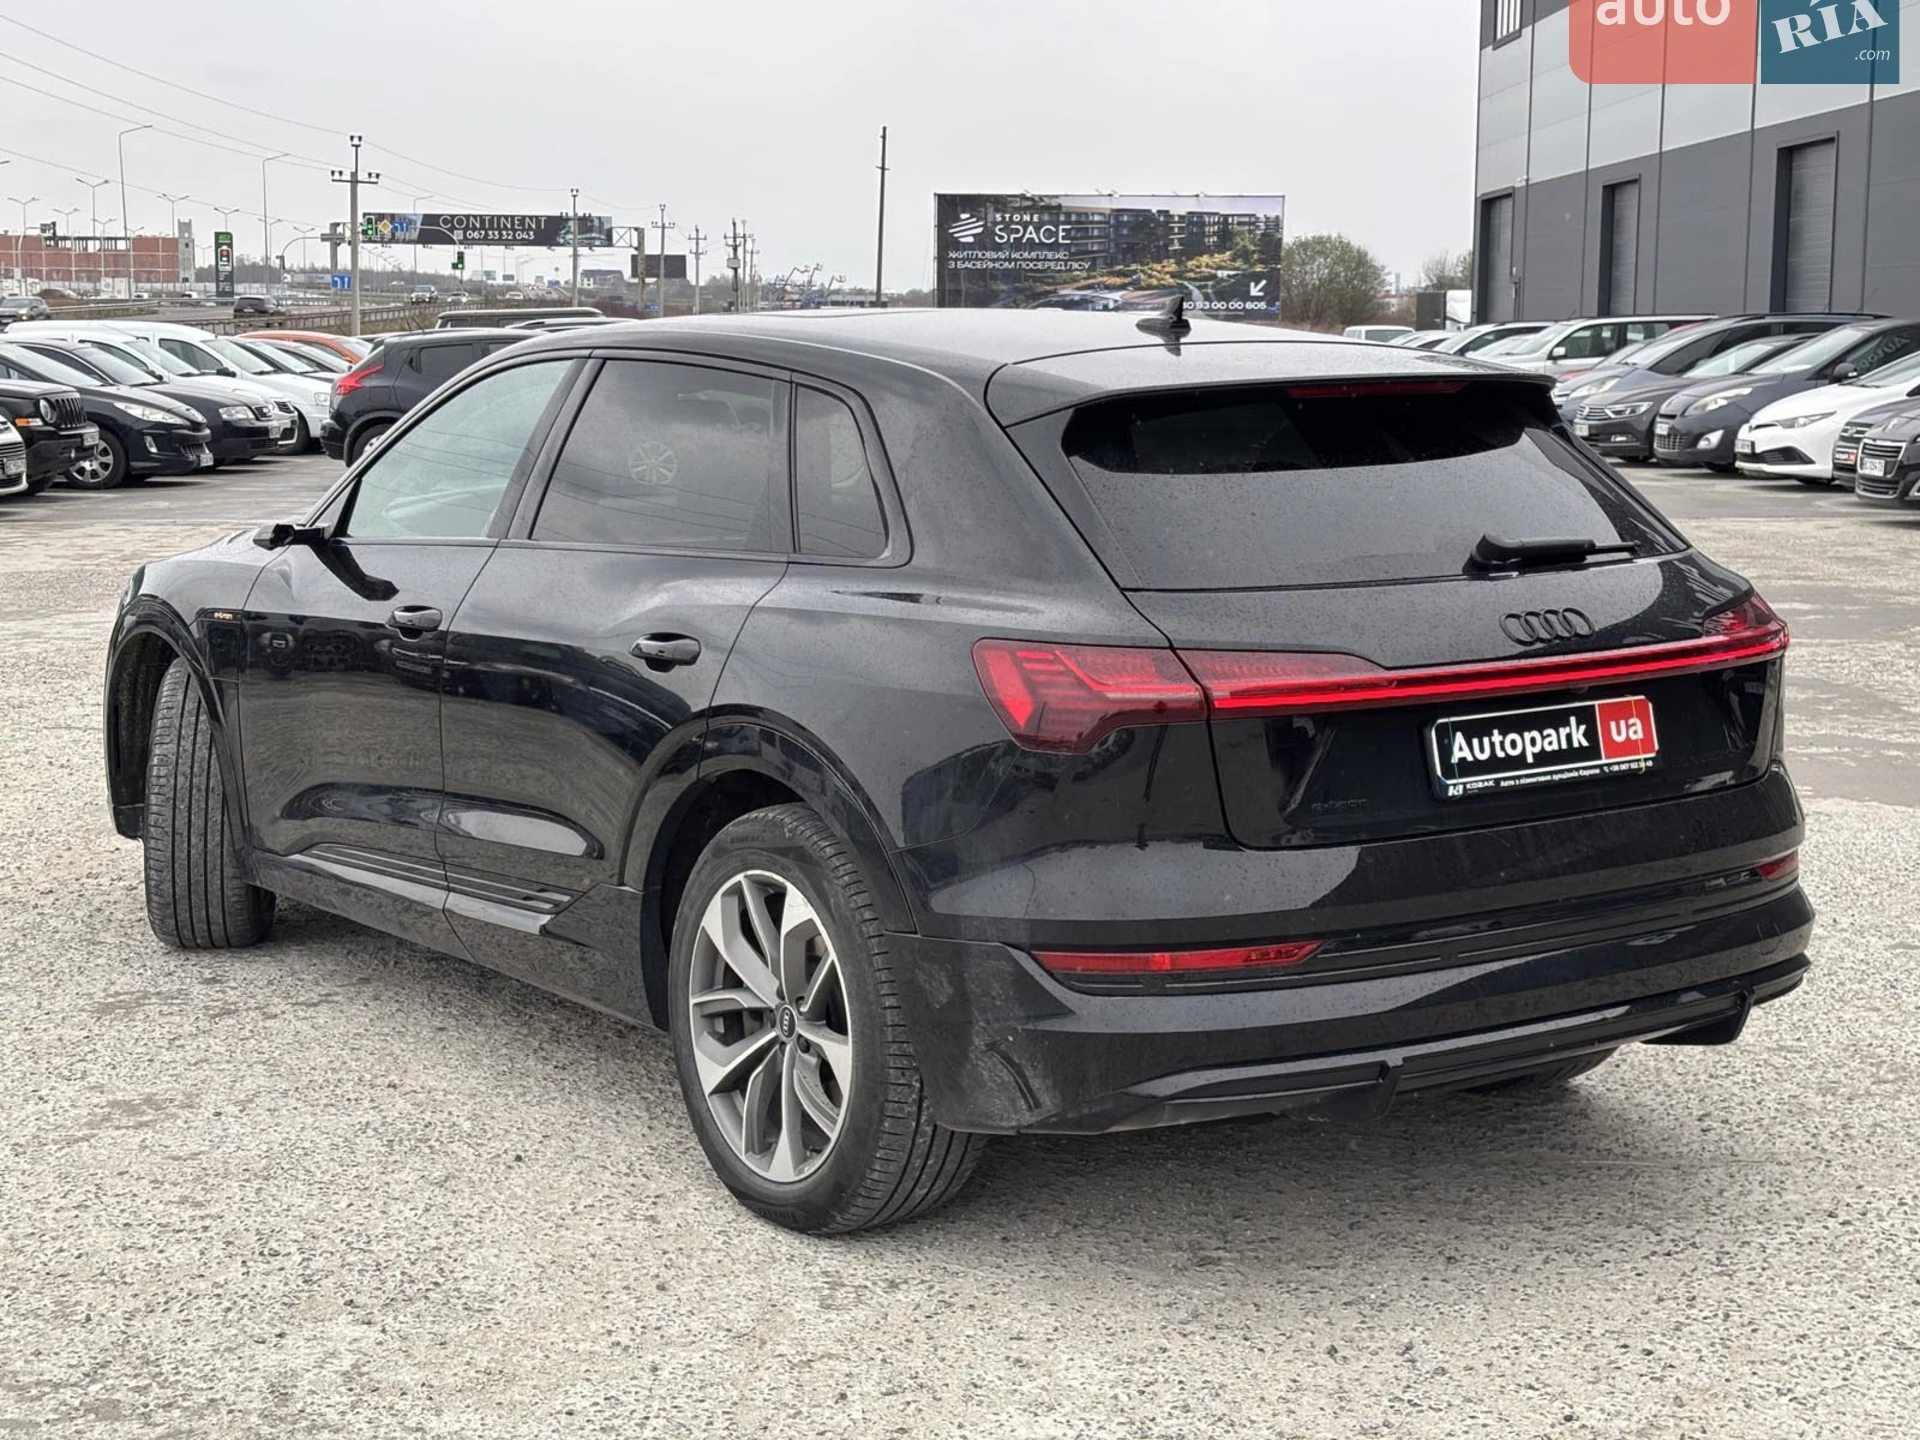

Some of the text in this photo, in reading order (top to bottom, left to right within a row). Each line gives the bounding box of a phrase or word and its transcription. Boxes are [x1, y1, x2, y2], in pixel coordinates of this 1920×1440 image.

[439, 215, 548, 230] CONTINENT
[995, 213, 1040, 222] STONE
[466, 230, 535, 240] 067 33 32 043
[995, 225, 1072, 243] SPACE
[948, 250, 1069, 260] ЖИТЛОВИЙ КОМПЛЕКС
[957, 260, 1015, 270] БАСЕЙНОМ
[1016, 261, 1065, 270] ПОСЕРЕД
[1196, 301, 1210, 309] 93
[1211, 301, 1227, 310] 00
[1228, 301, 1244, 310] 00
[1245, 301, 1267, 310] 605
[1451, 716, 1643, 764] Autopark ua
